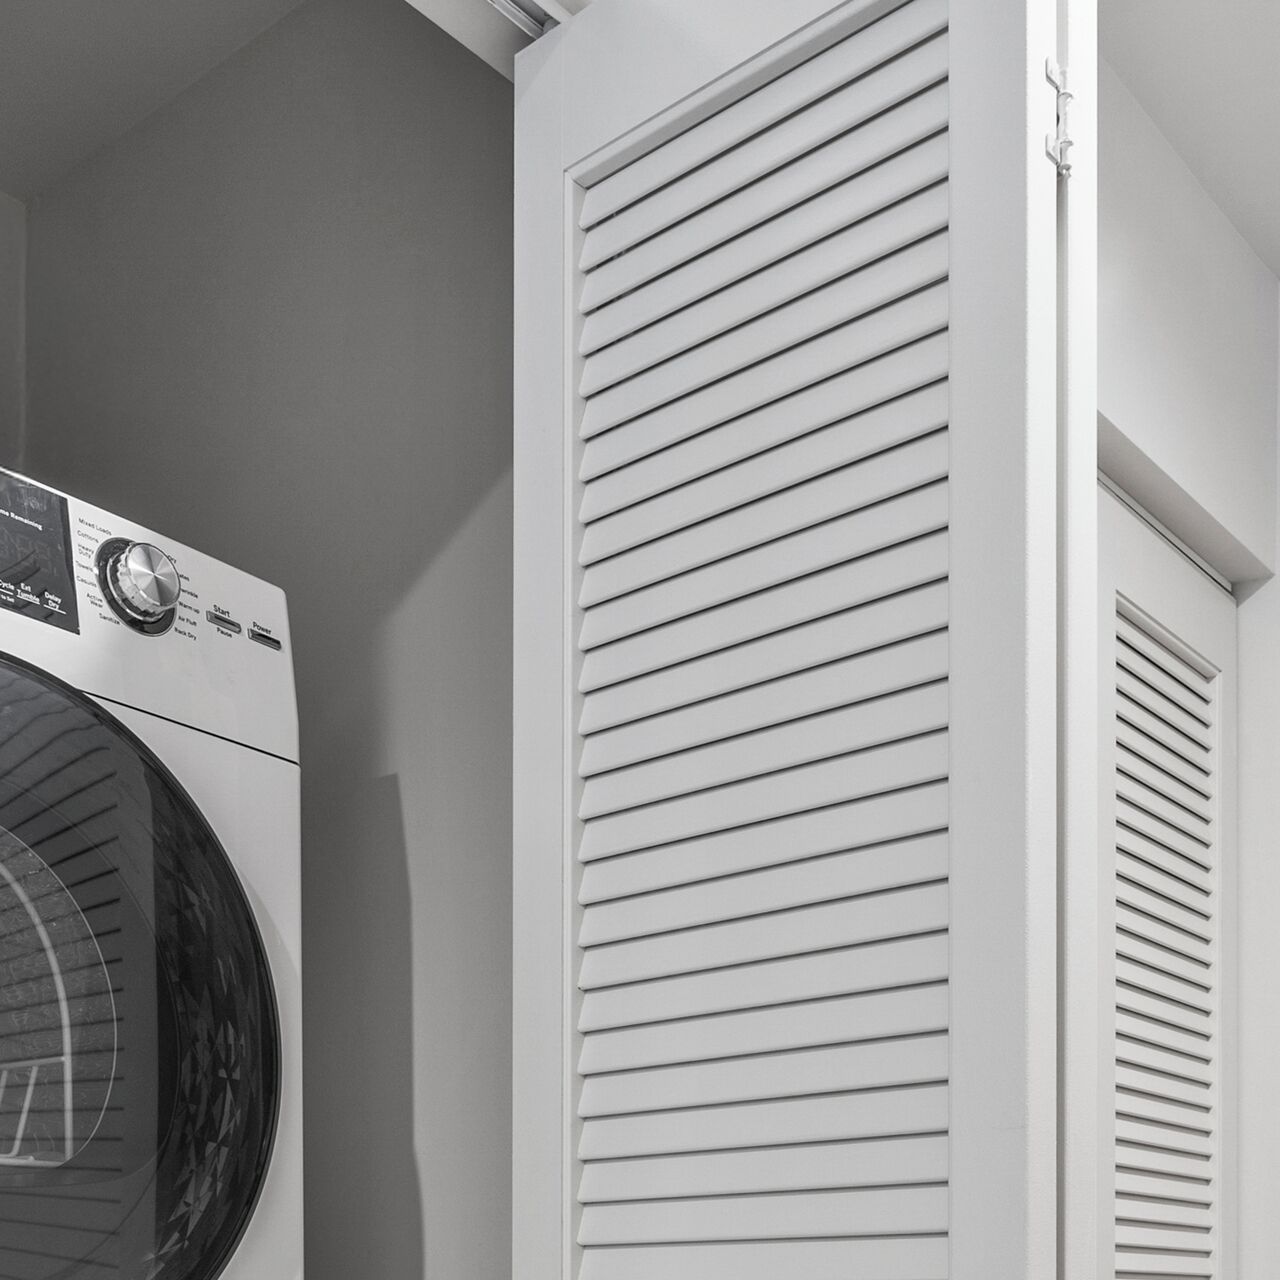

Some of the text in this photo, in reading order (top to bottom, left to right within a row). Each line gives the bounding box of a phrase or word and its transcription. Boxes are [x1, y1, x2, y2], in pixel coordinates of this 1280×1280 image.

[10, 511, 42, 530] Remaining
[45, 591, 62, 604] Delay
[48, 600, 60, 610] Dry
[213, 604, 231, 618] Start
[216, 627, 232, 638] Pause
[253, 621, 272, 634] Power
